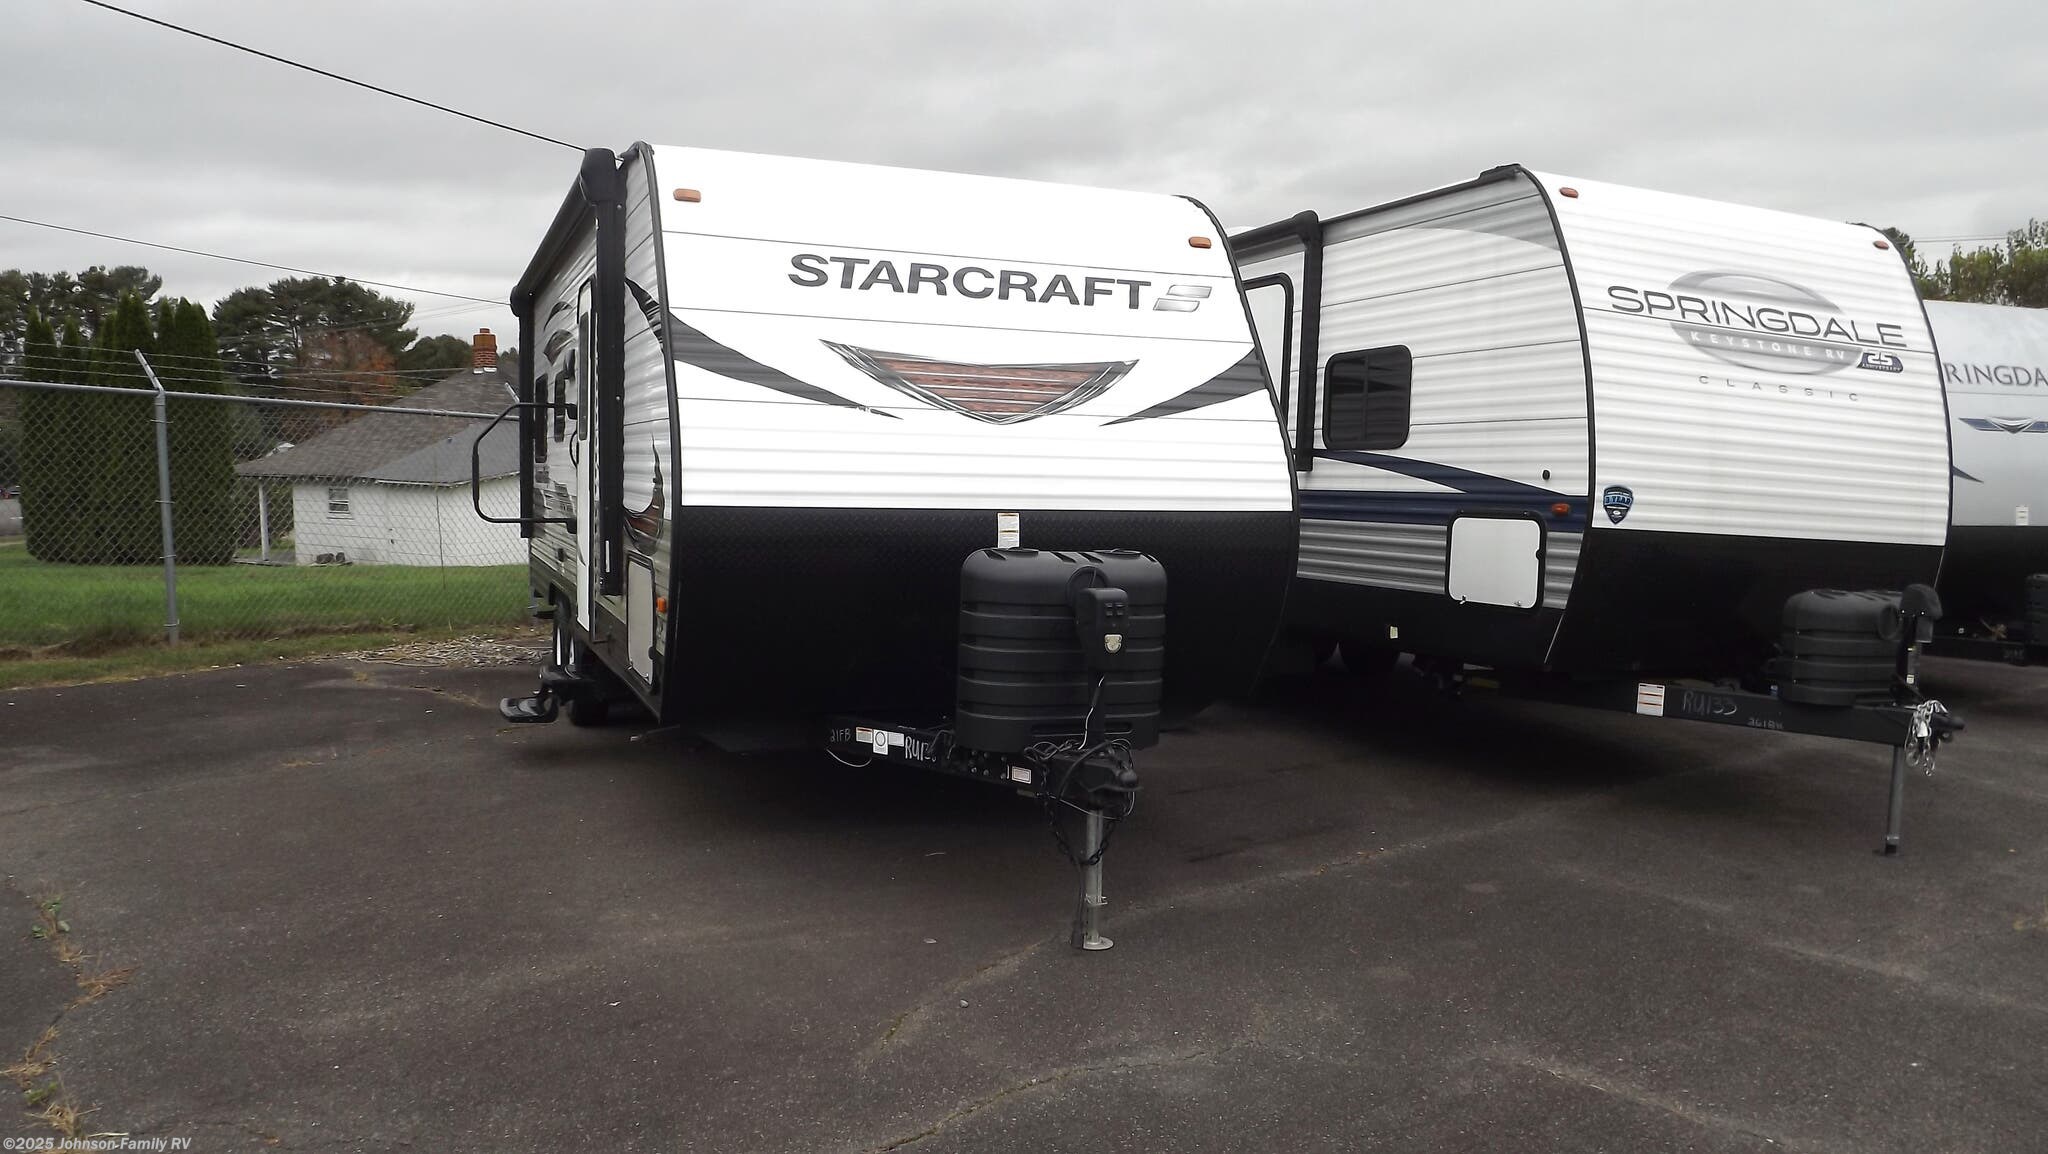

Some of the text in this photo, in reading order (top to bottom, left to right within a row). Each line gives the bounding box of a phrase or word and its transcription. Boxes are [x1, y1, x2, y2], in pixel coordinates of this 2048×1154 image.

[787, 252, 1152, 311] STARCRAFT
[1606, 285, 1908, 348] SPRINGDALE
[1689, 329, 1847, 361] KEYSTONE RV
[1866, 350, 1894, 367] 25
[1698, 375, 1860, 402] CLASSIC
